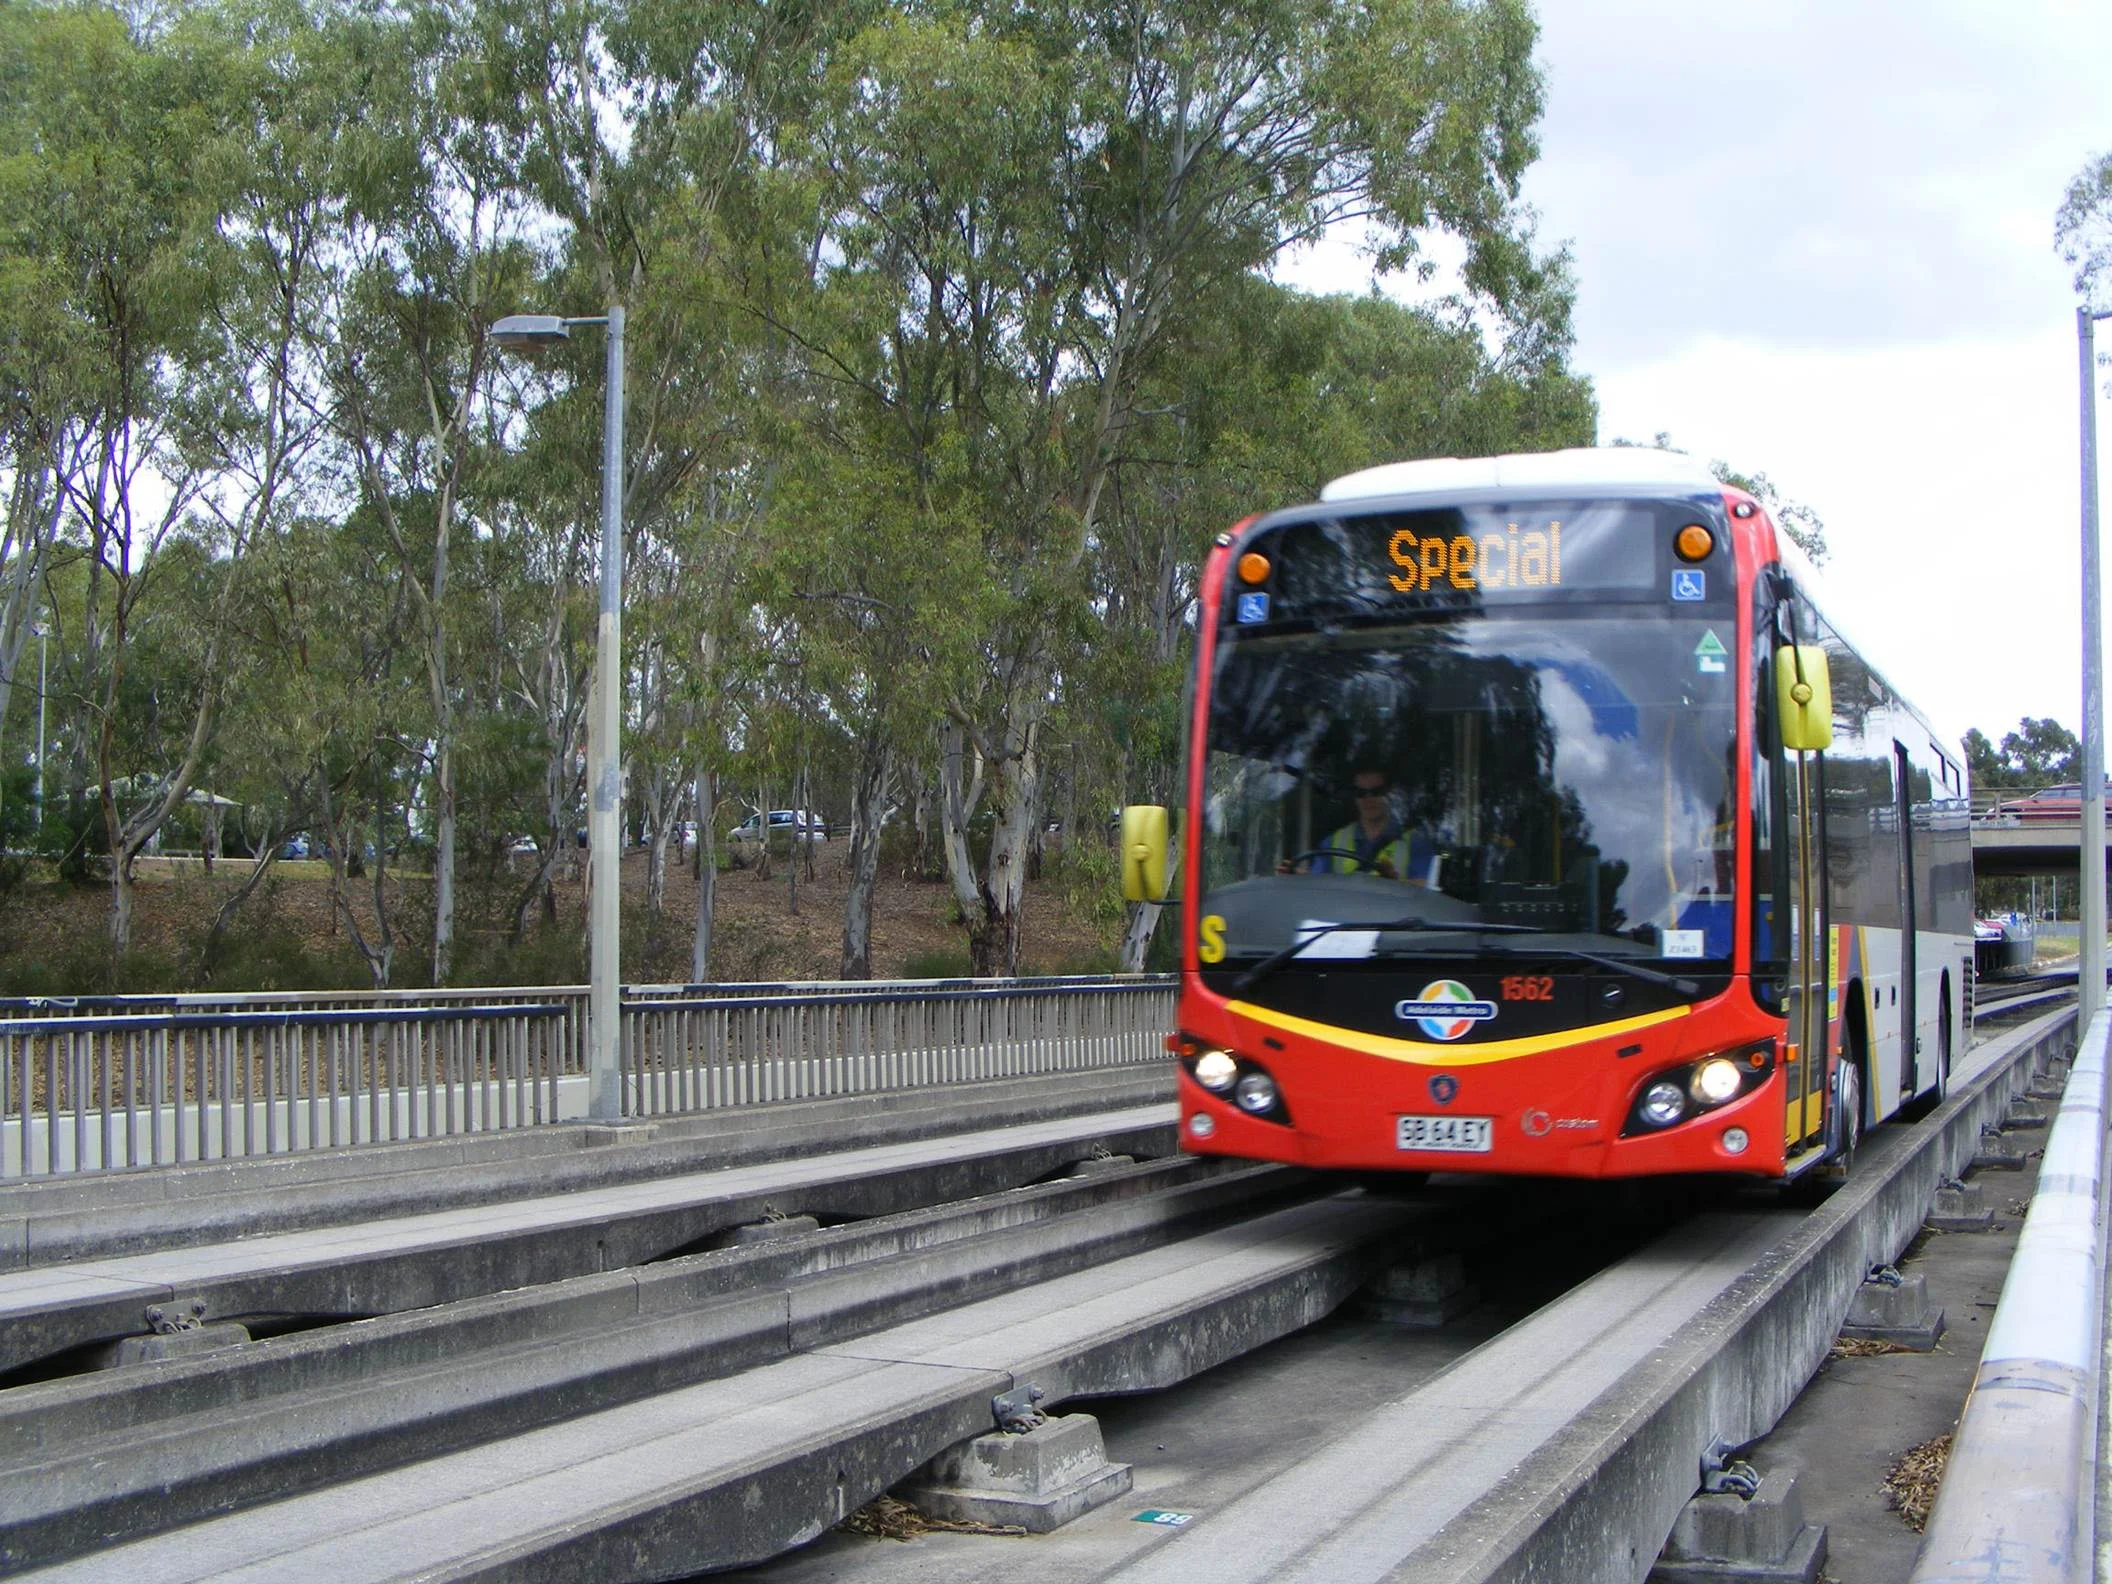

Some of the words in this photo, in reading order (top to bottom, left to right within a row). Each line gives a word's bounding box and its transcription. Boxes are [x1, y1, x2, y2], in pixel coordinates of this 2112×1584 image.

[1388, 520, 1560, 592] Special
[1200, 914, 1227, 963] S
[1499, 976, 1554, 1001] 1562
[1405, 1005, 1452, 1015] Adelaide
[1454, 1006, 1488, 1016] Metro
